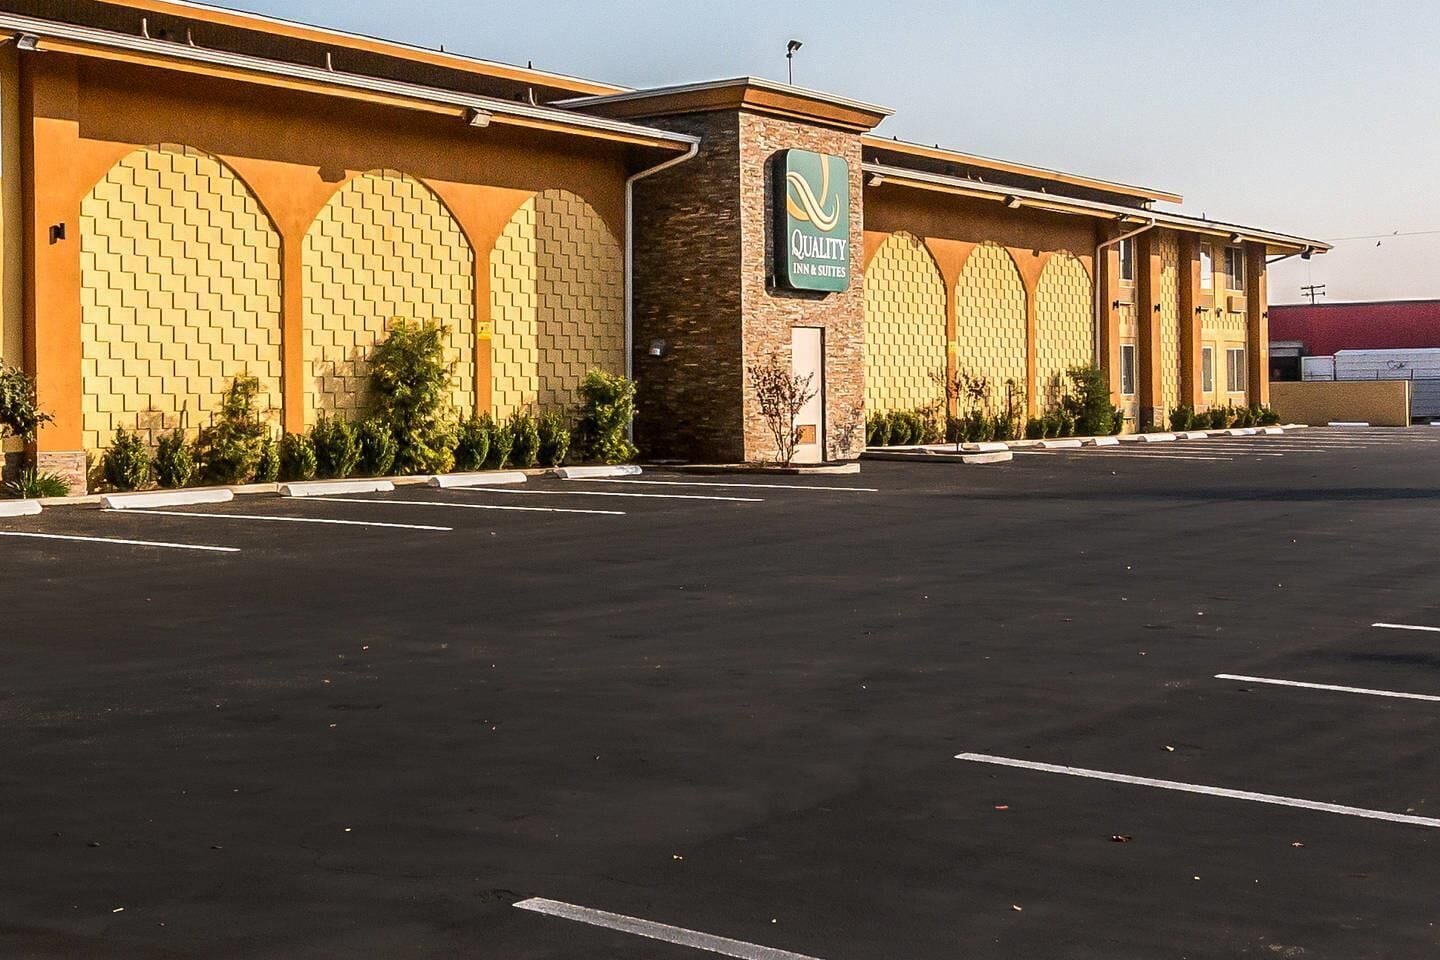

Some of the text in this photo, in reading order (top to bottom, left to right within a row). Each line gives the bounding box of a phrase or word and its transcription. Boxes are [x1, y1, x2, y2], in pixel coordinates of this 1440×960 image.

[791, 228, 847, 260] QUALITY
[793, 262, 846, 278] INN & SUITES
